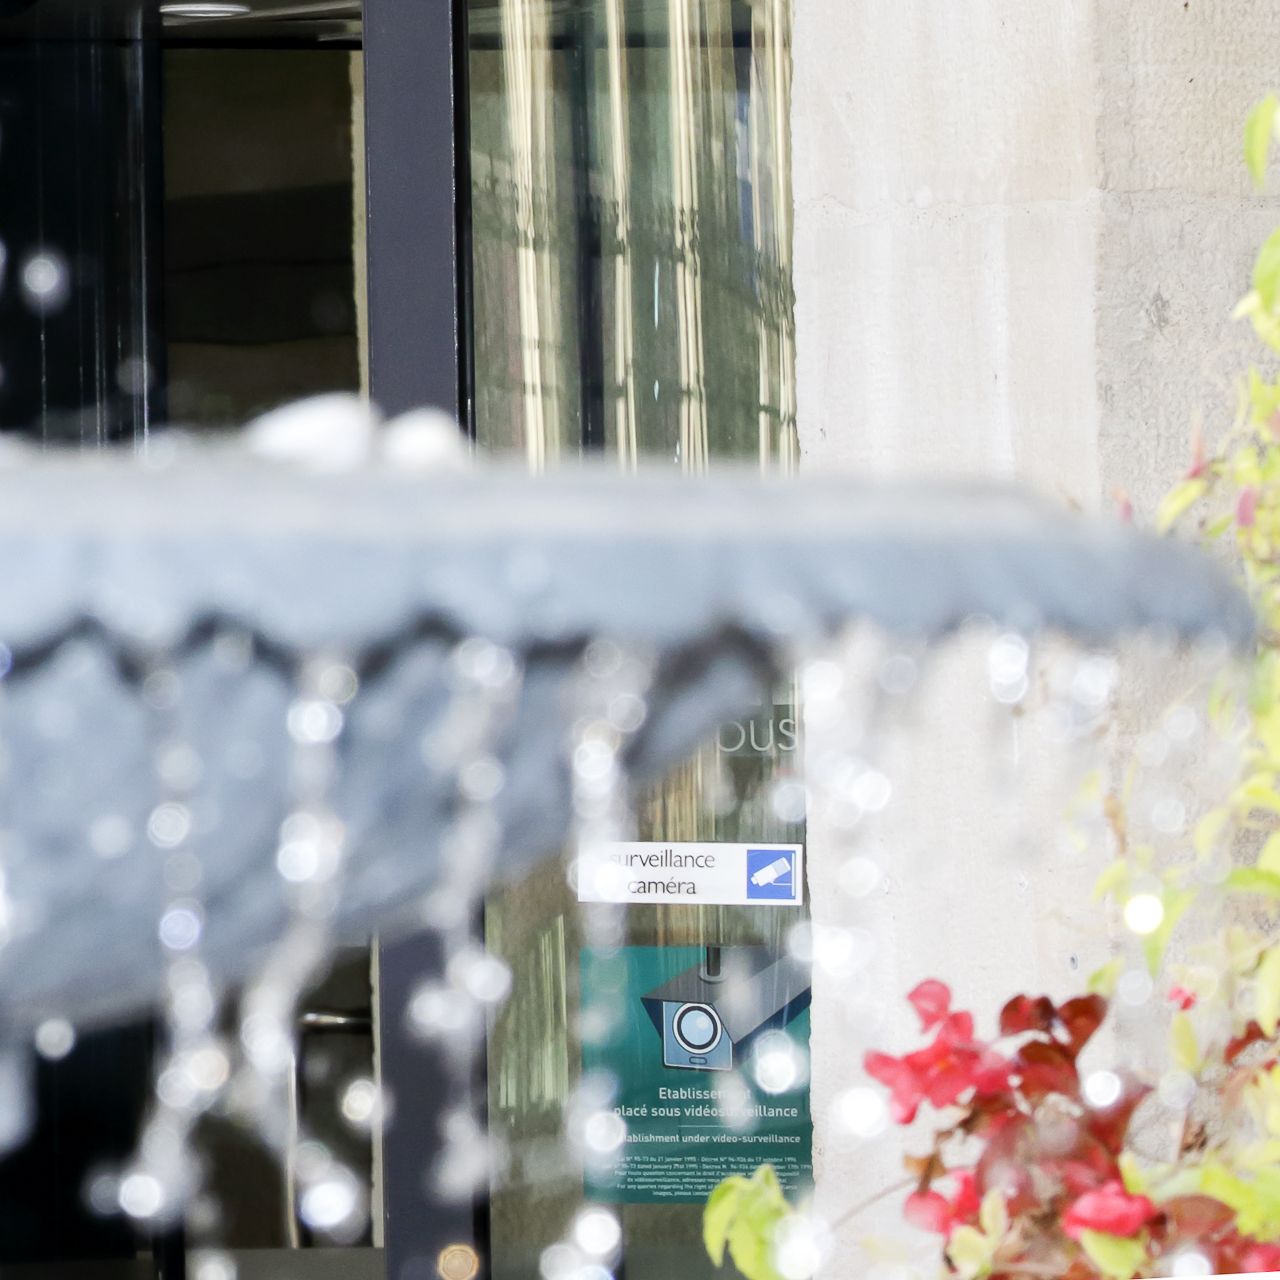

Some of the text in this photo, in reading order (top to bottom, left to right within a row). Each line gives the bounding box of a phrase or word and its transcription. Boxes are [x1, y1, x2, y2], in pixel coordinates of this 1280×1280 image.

[627, 876, 697, 895] caméra
[651, 1107, 681, 1117] sous
[682, 1133, 710, 1143] under
